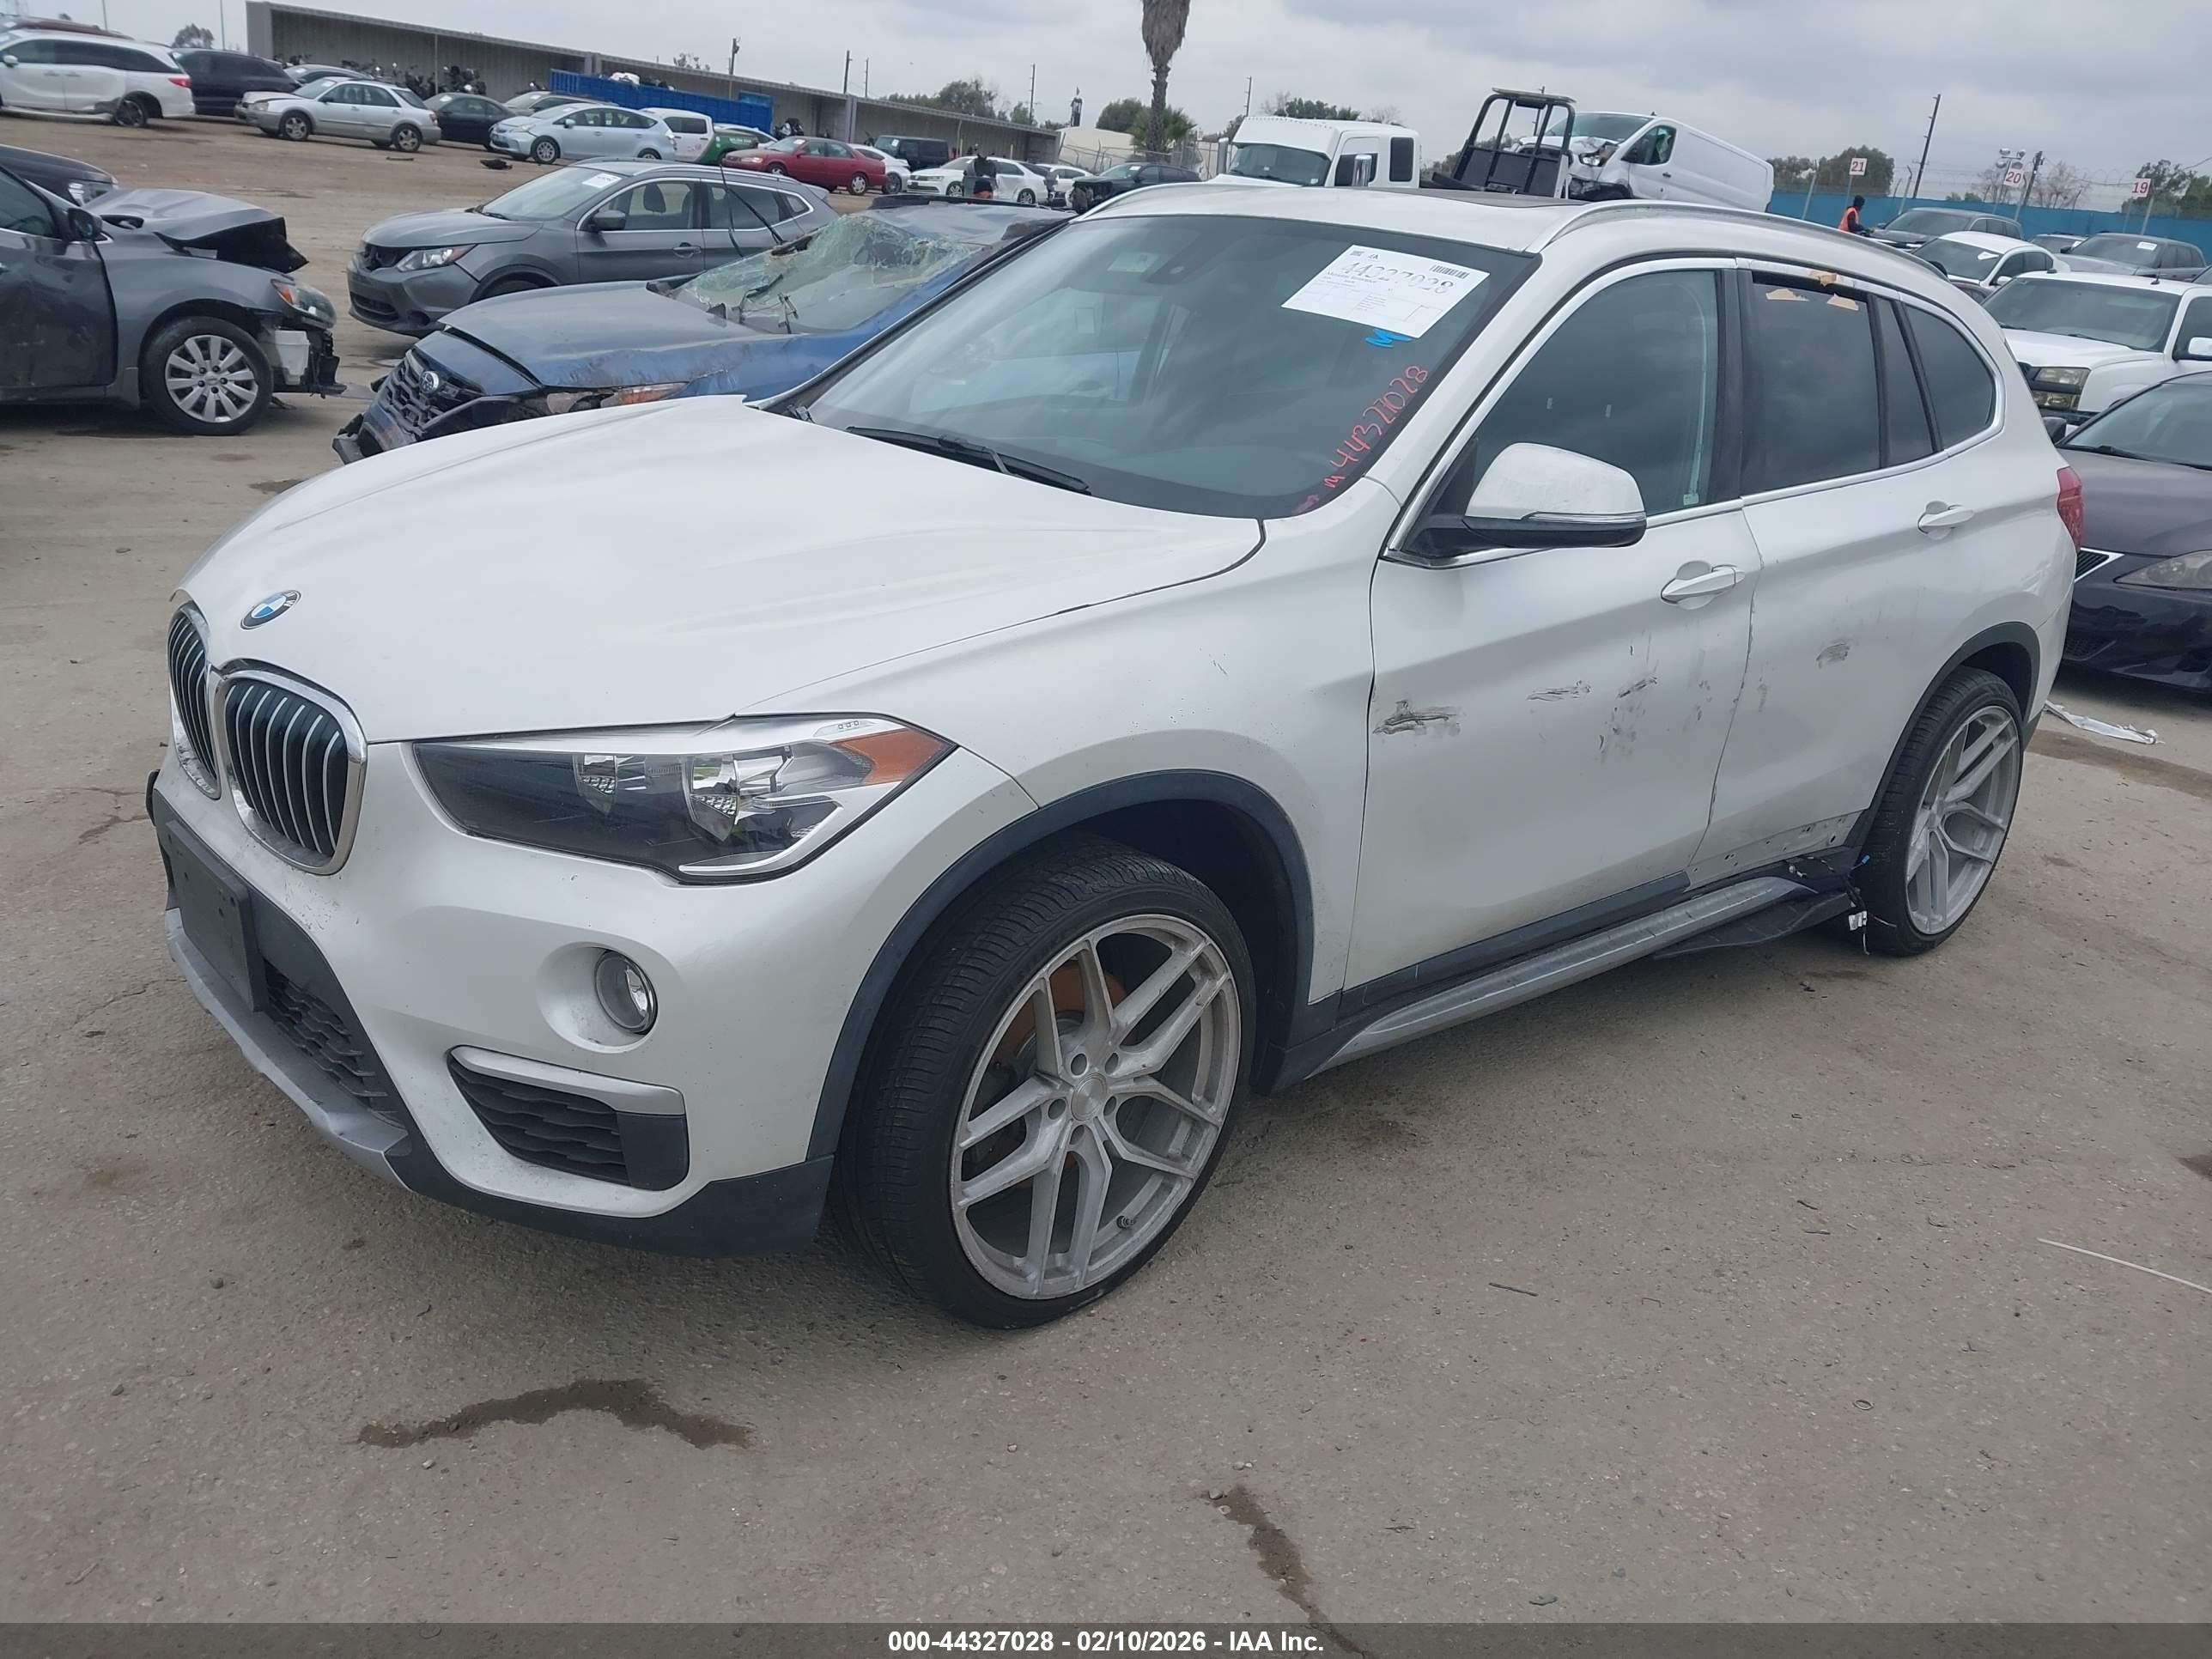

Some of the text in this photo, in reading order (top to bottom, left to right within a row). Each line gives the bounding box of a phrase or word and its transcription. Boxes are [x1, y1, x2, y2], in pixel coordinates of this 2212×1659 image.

[1850, 161, 1863, 172] 21
[2005, 171, 2021, 184] 20
[2131, 181, 2148, 194] 19
[1330, 365, 1428, 467] 44327028
